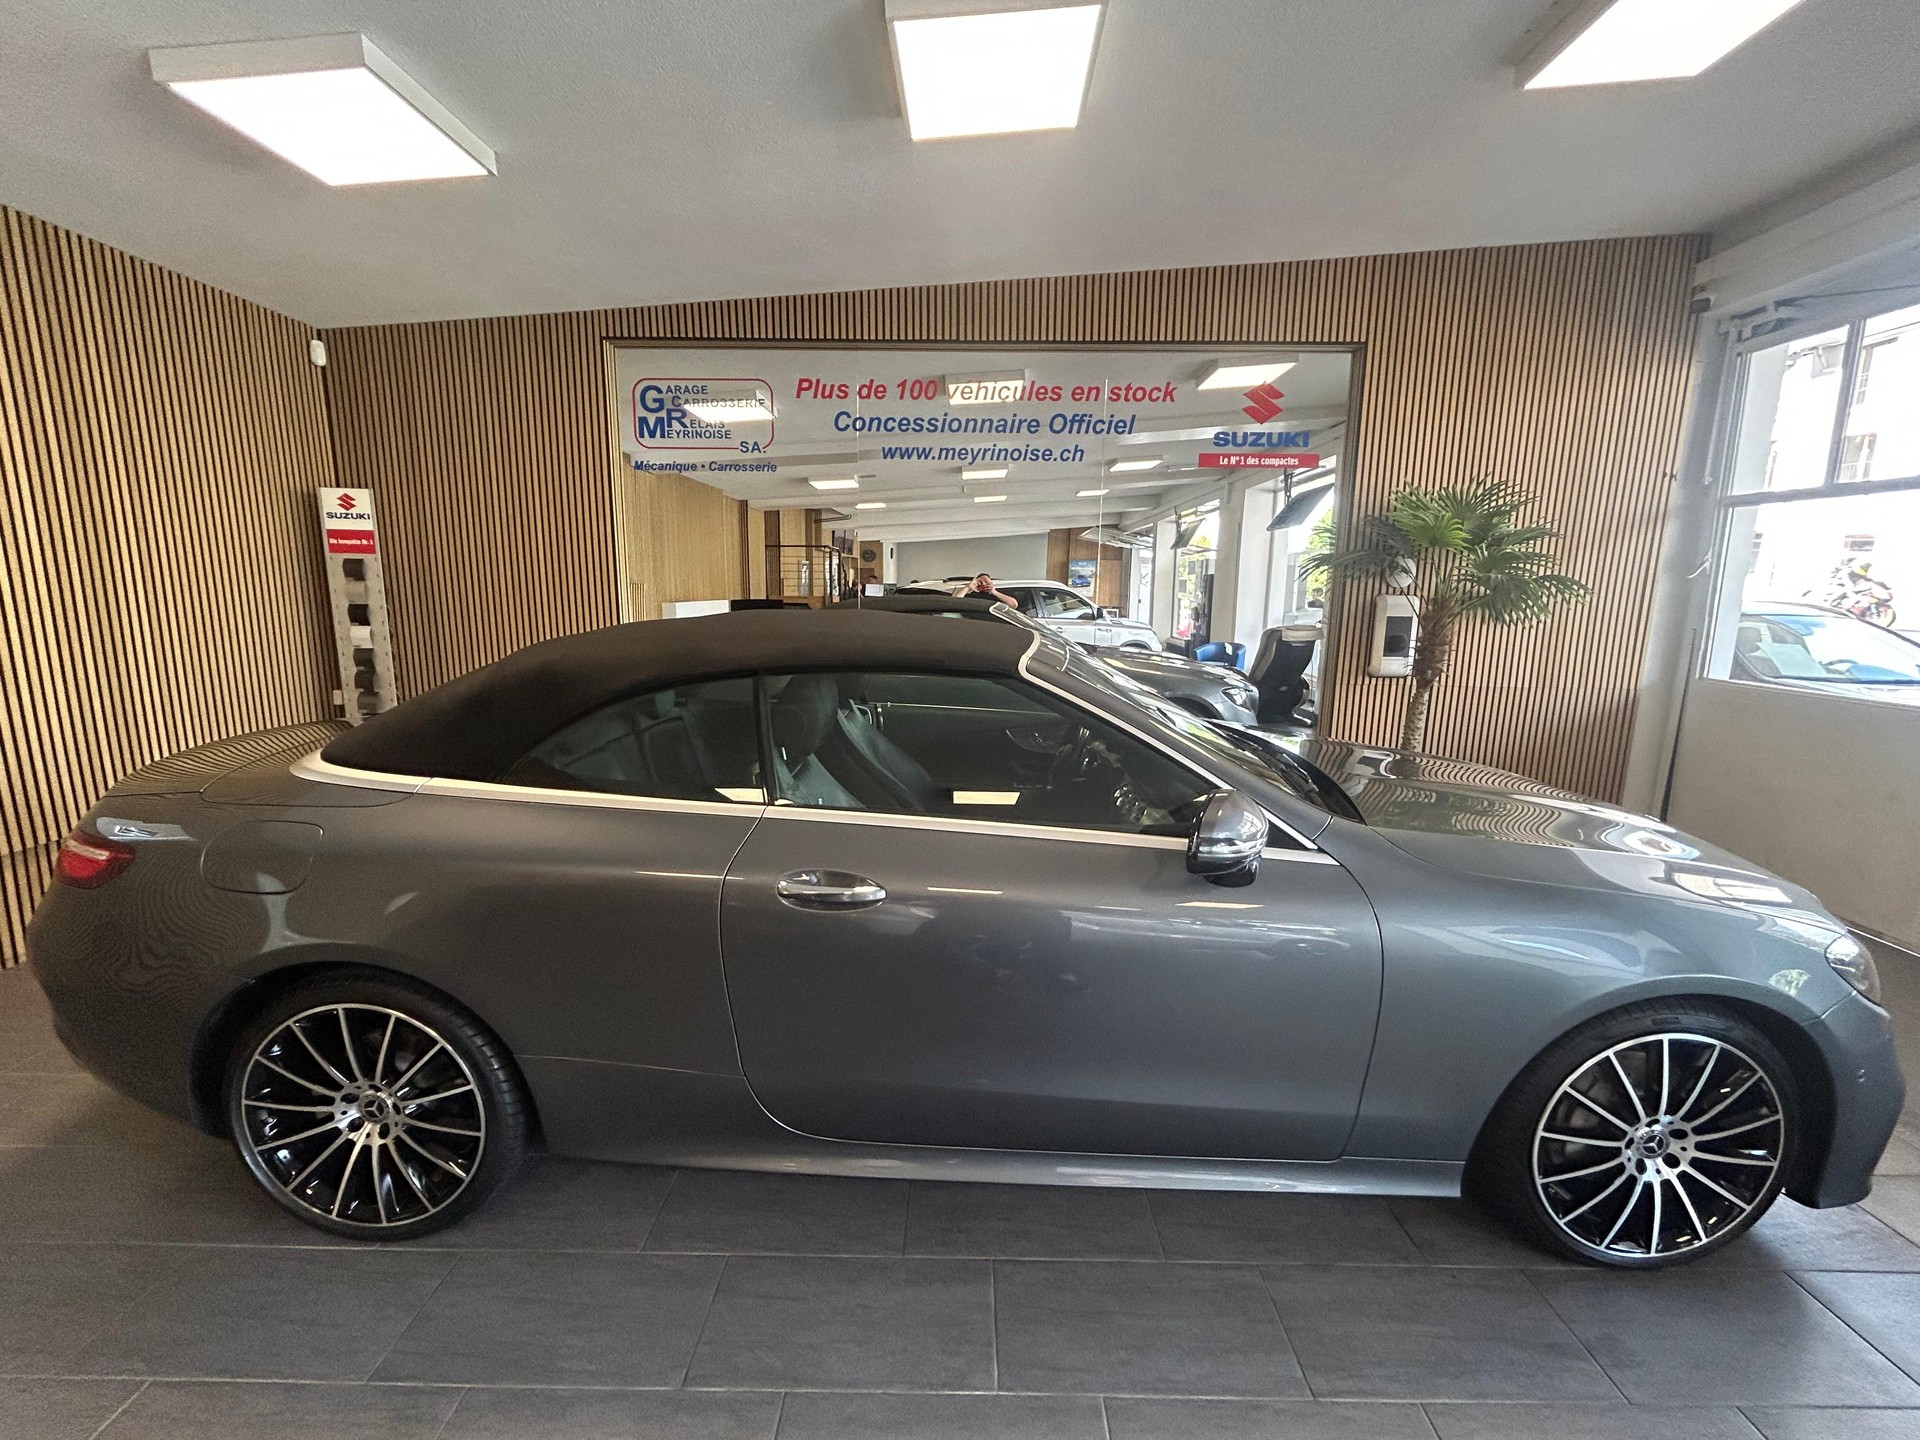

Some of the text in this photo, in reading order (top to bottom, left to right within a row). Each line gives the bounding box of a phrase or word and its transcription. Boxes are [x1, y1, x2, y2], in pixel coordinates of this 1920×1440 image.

[795, 378, 850, 400] Plus
[857, 379, 888, 400] de
[896, 379, 938, 401] 100
[1070, 385, 1101, 402] en
[1107, 381, 1178, 403] stock
[833, 410, 1137, 435] Concessionnaire Officiel
[1212, 431, 1310, 448] SUZUKI
[881, 444, 1085, 466] www.meyrinoise.ch
[1219, 455, 1229, 465] Le
[1246, 455, 1259, 465] des
[1261, 456, 1299, 467] compactes
[633, 460, 778, 476] Mécanique Carrosserie
[325, 511, 371, 520] SUZUKI
